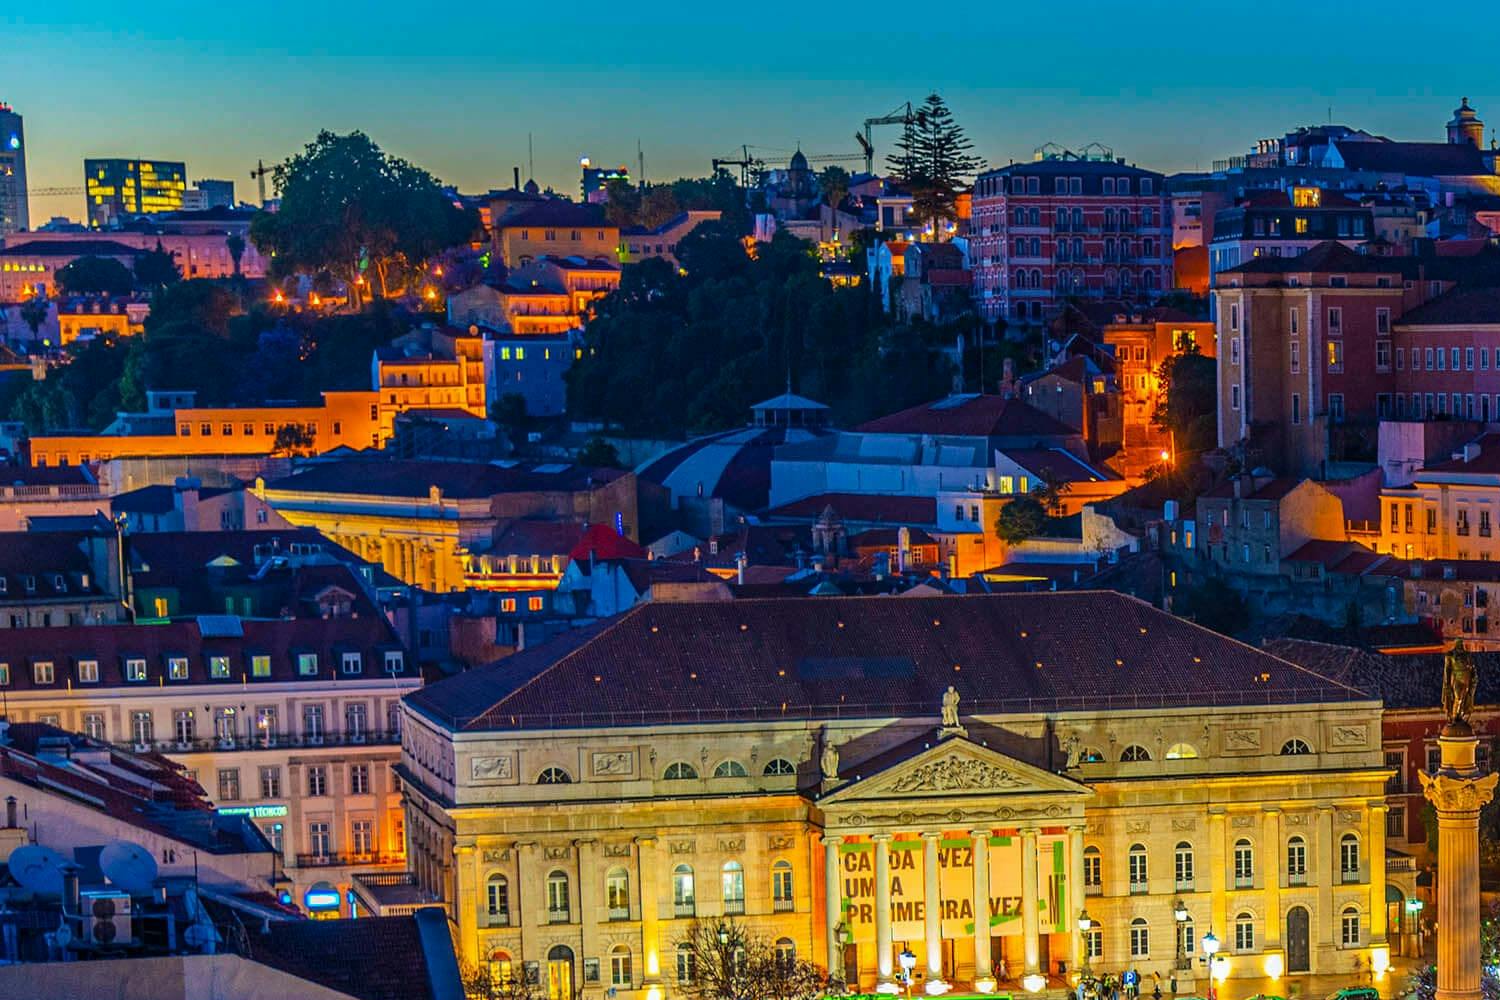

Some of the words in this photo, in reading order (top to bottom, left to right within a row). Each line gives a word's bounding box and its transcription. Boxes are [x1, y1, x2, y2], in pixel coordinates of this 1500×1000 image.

[938, 847, 973, 868] VEZ
[845, 876, 903, 898] UMA
[988, 896, 1023, 917] VEZ
